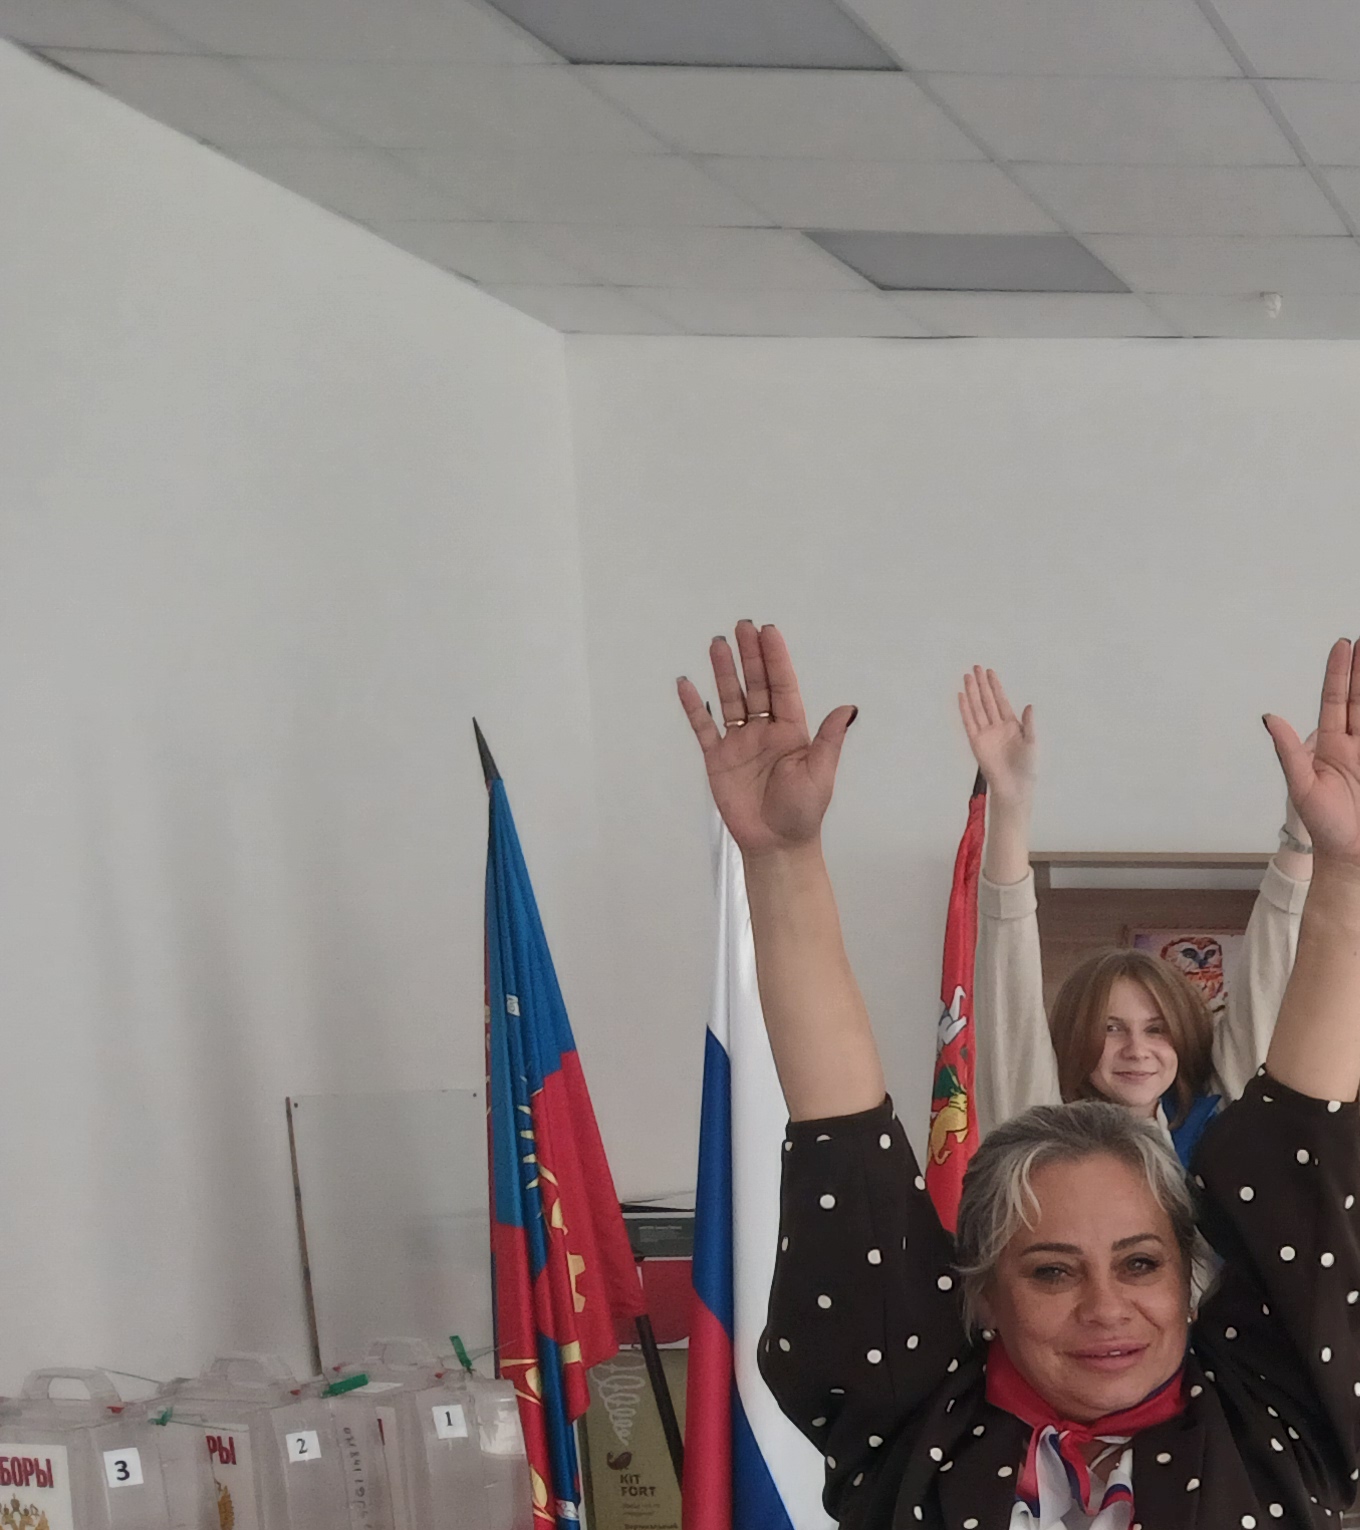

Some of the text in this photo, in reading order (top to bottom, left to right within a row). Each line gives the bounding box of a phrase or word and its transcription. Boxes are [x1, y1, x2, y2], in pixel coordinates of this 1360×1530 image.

[445, 1410, 453, 1427] 1
[296, 1438, 308, 1454] 2
[114, 1460, 130, 1481] 3
[620, 1474, 640, 1486] KIT
[621, 1486, 656, 1497] FORT
